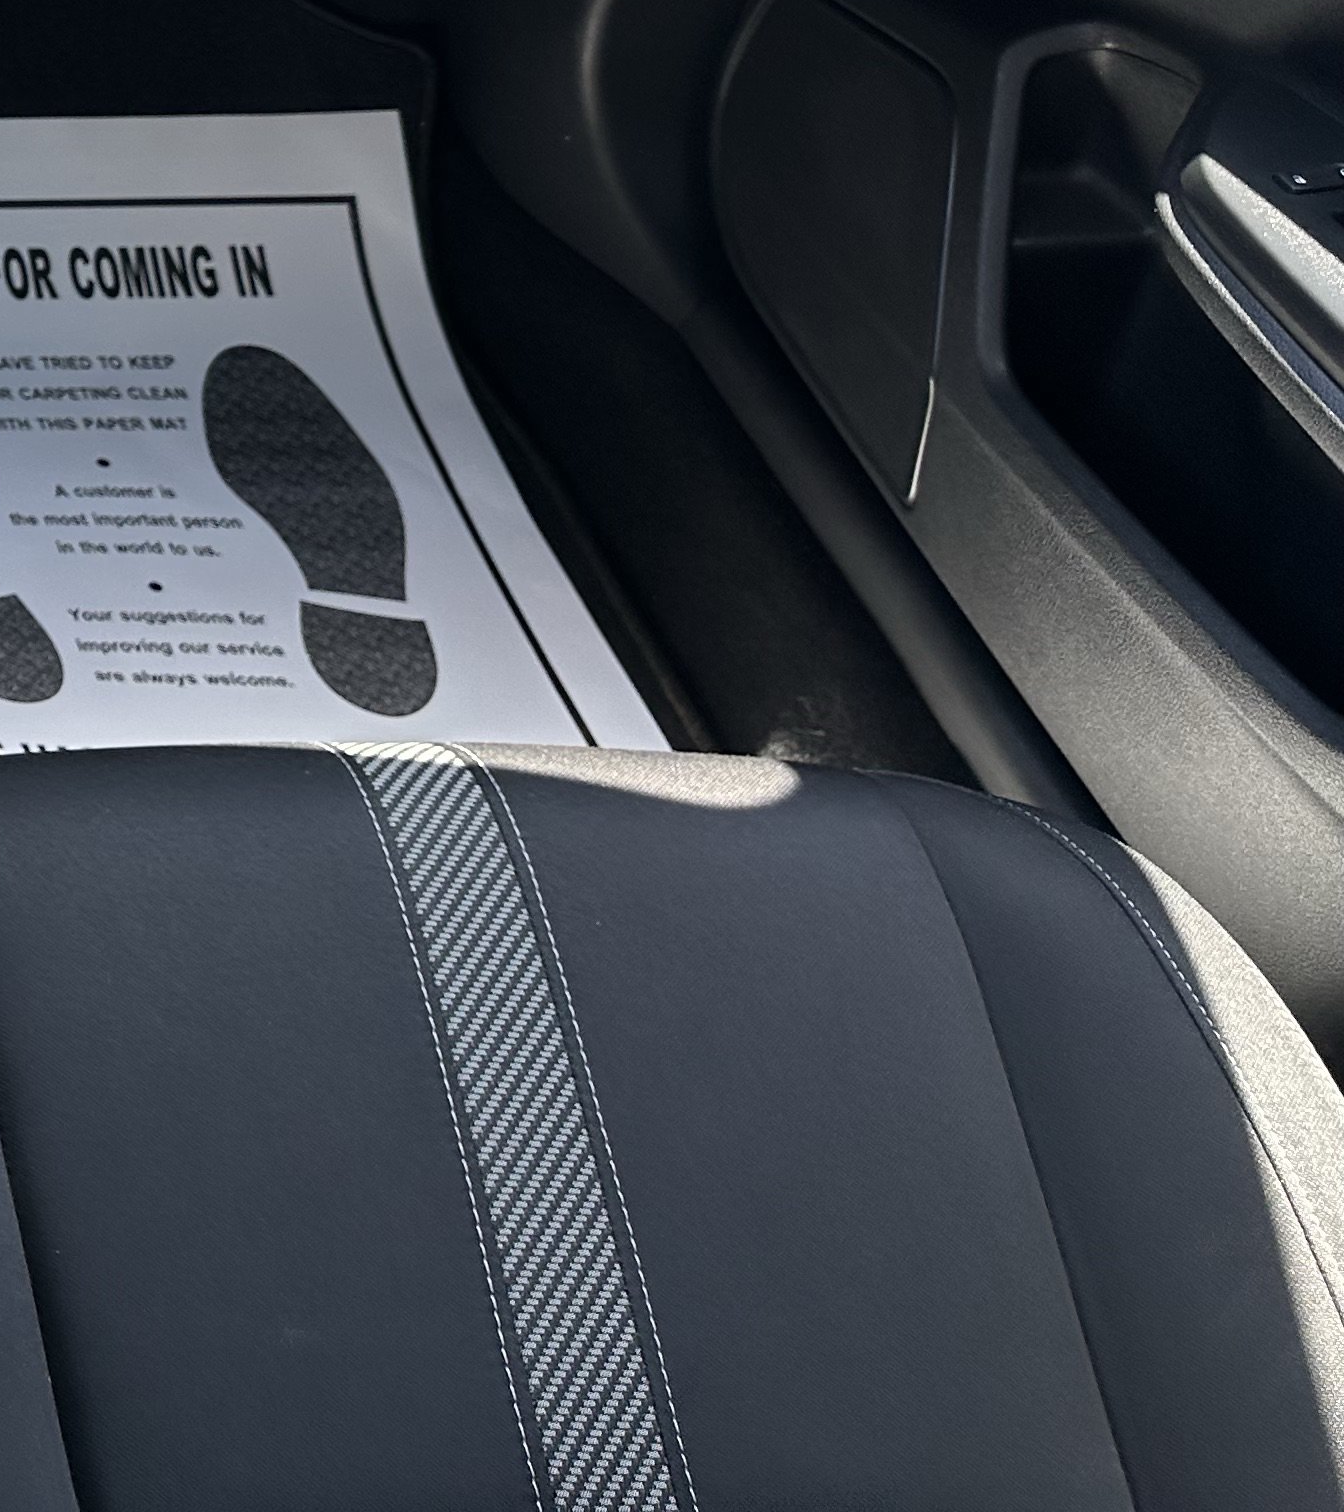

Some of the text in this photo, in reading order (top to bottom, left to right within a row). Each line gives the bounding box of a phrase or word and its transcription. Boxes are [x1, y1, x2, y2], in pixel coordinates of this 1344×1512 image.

[69, 244, 220, 299] COMING
[228, 244, 275, 298] IN
[39, 355, 93, 371] TRIED
[96, 355, 123, 370] TO
[127, 354, 176, 370] KEEP
[18, 387, 121, 402] CARPETING
[125, 387, 189, 401] CLEAN
[36, 416, 78, 431] THIS
[83, 416, 145, 431] PAPER
[149, 416, 188, 431] MAT
[73, 485, 154, 498] customer
[159, 484, 177, 499] is
[9, 512, 243, 530] the most important person
[78, 541, 108, 554] the
[113, 541, 165, 555] world
[68, 608, 265, 626] Your suggestions for
[75, 638, 285, 657] improving our service
[95, 670, 125, 682] are
[132, 670, 197, 687] always
